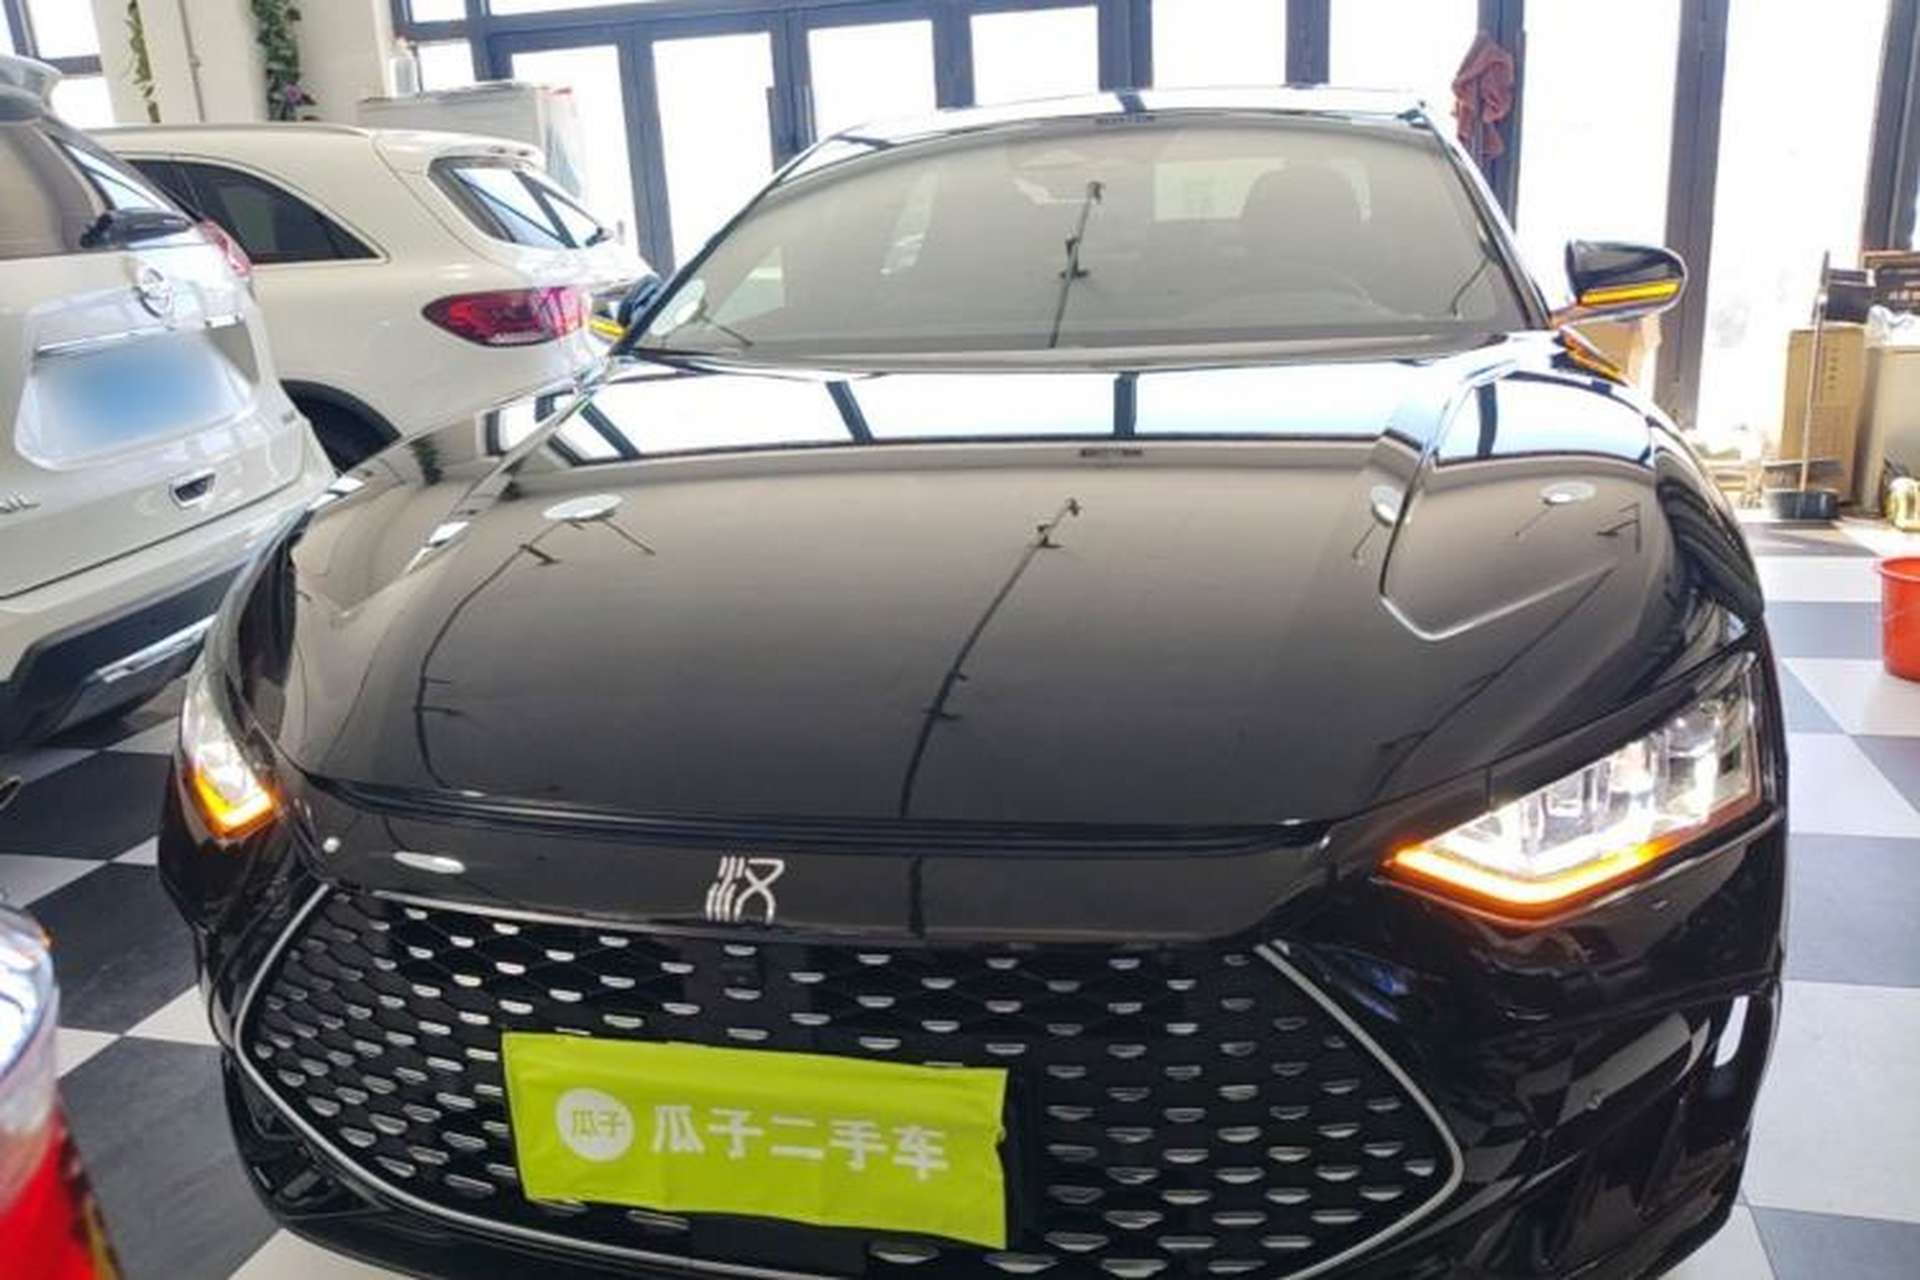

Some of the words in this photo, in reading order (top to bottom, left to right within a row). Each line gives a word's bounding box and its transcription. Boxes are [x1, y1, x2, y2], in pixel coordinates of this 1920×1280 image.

[571, 1109, 625, 1138] 瓜子
[651, 1104, 949, 1180] 瓜子二手车
